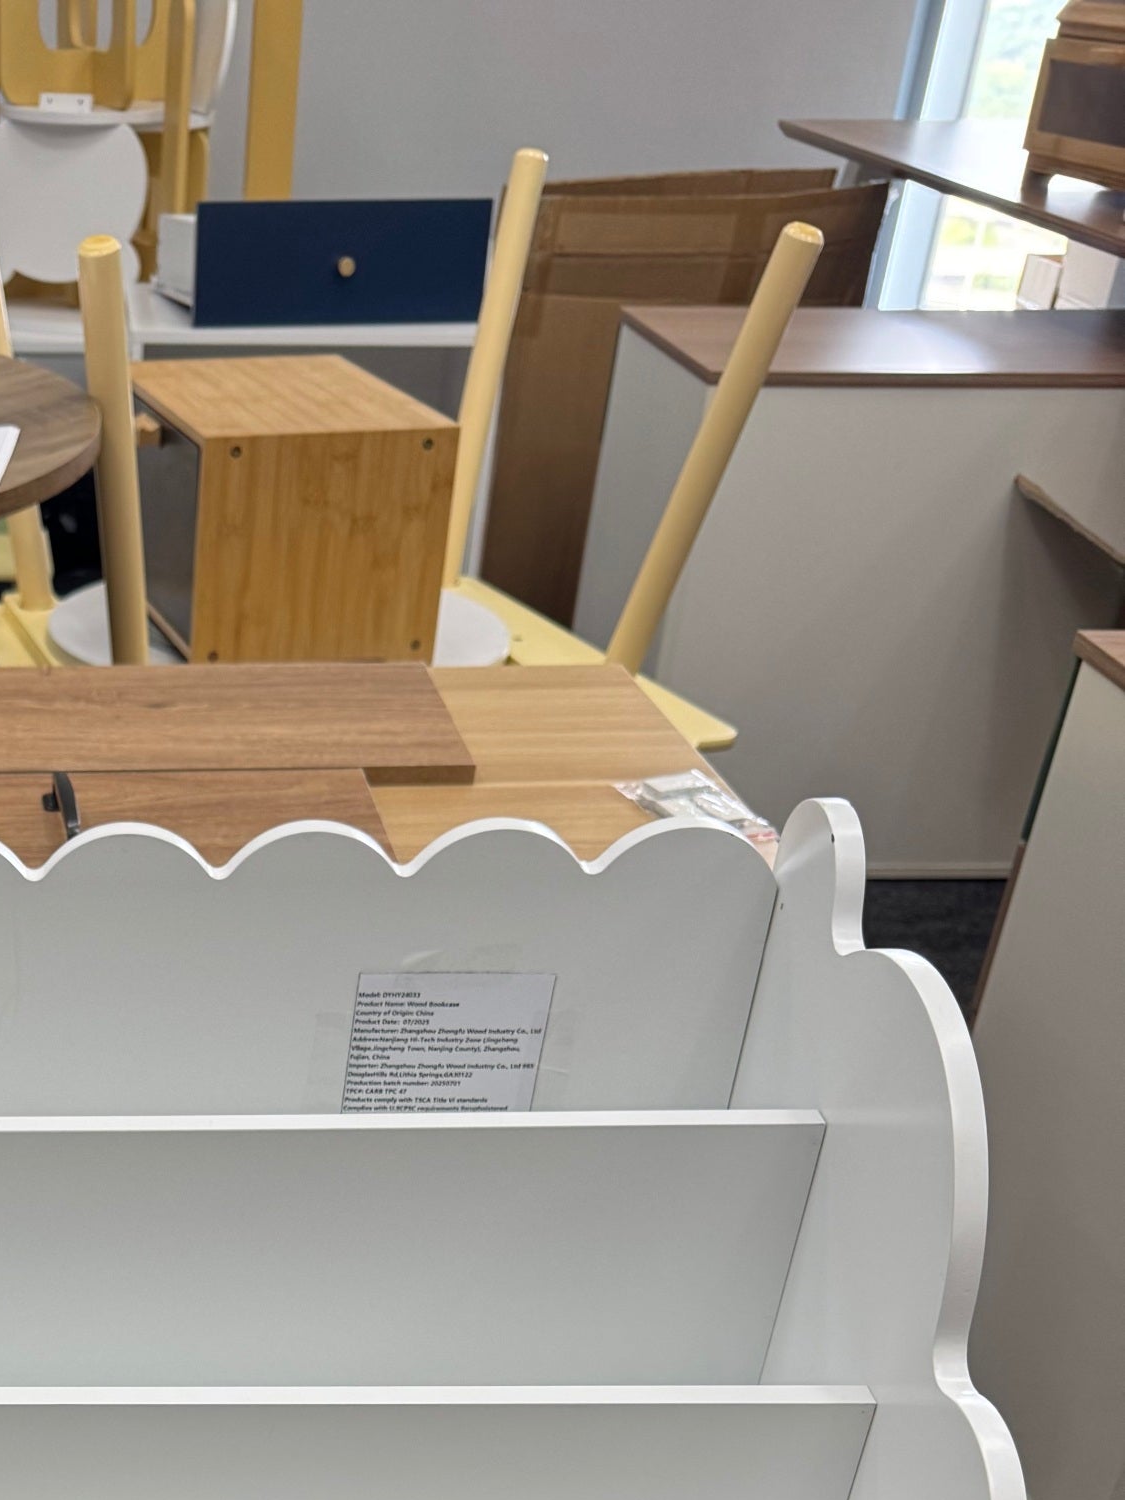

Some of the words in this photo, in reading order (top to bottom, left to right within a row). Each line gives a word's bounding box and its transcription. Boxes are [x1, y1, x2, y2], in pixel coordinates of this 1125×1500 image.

[355, 1010, 381, 1018] Country
[392, 1010, 414, 1018] Origin:
[488, 1028, 515, 1036] Industry
[437, 1036, 463, 1044] Industry
[467, 1063, 495, 1071] Industry
[374, 1097, 396, 1105] comply
